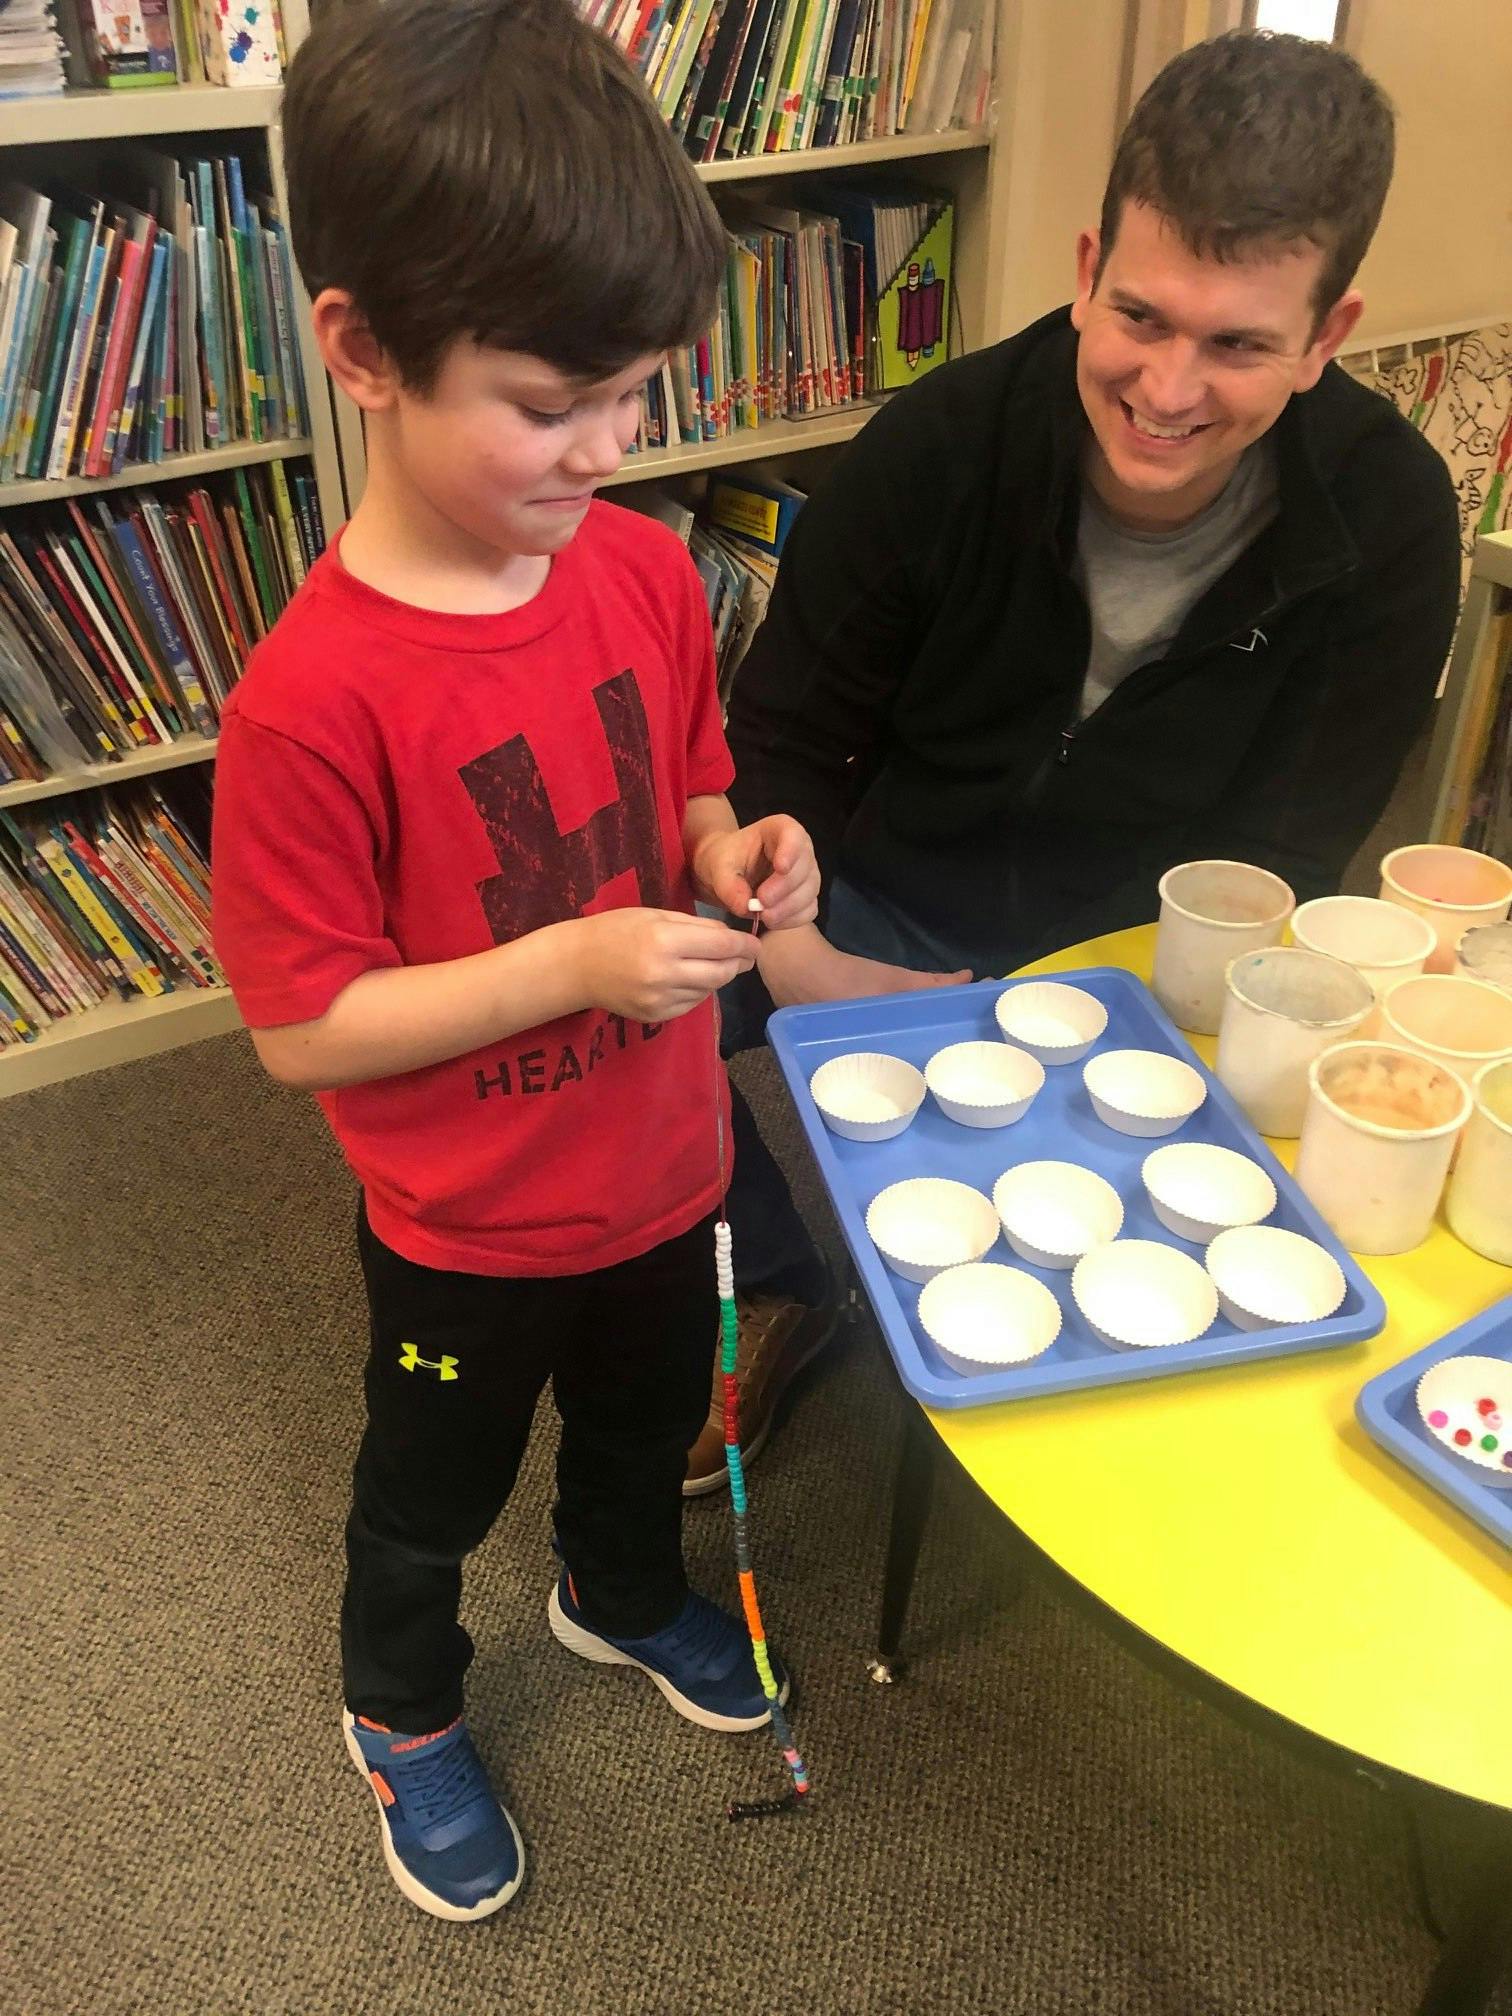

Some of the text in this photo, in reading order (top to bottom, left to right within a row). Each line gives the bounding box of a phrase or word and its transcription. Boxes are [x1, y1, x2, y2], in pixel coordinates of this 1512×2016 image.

[132, 549, 180, 652] Count Your Blessings
